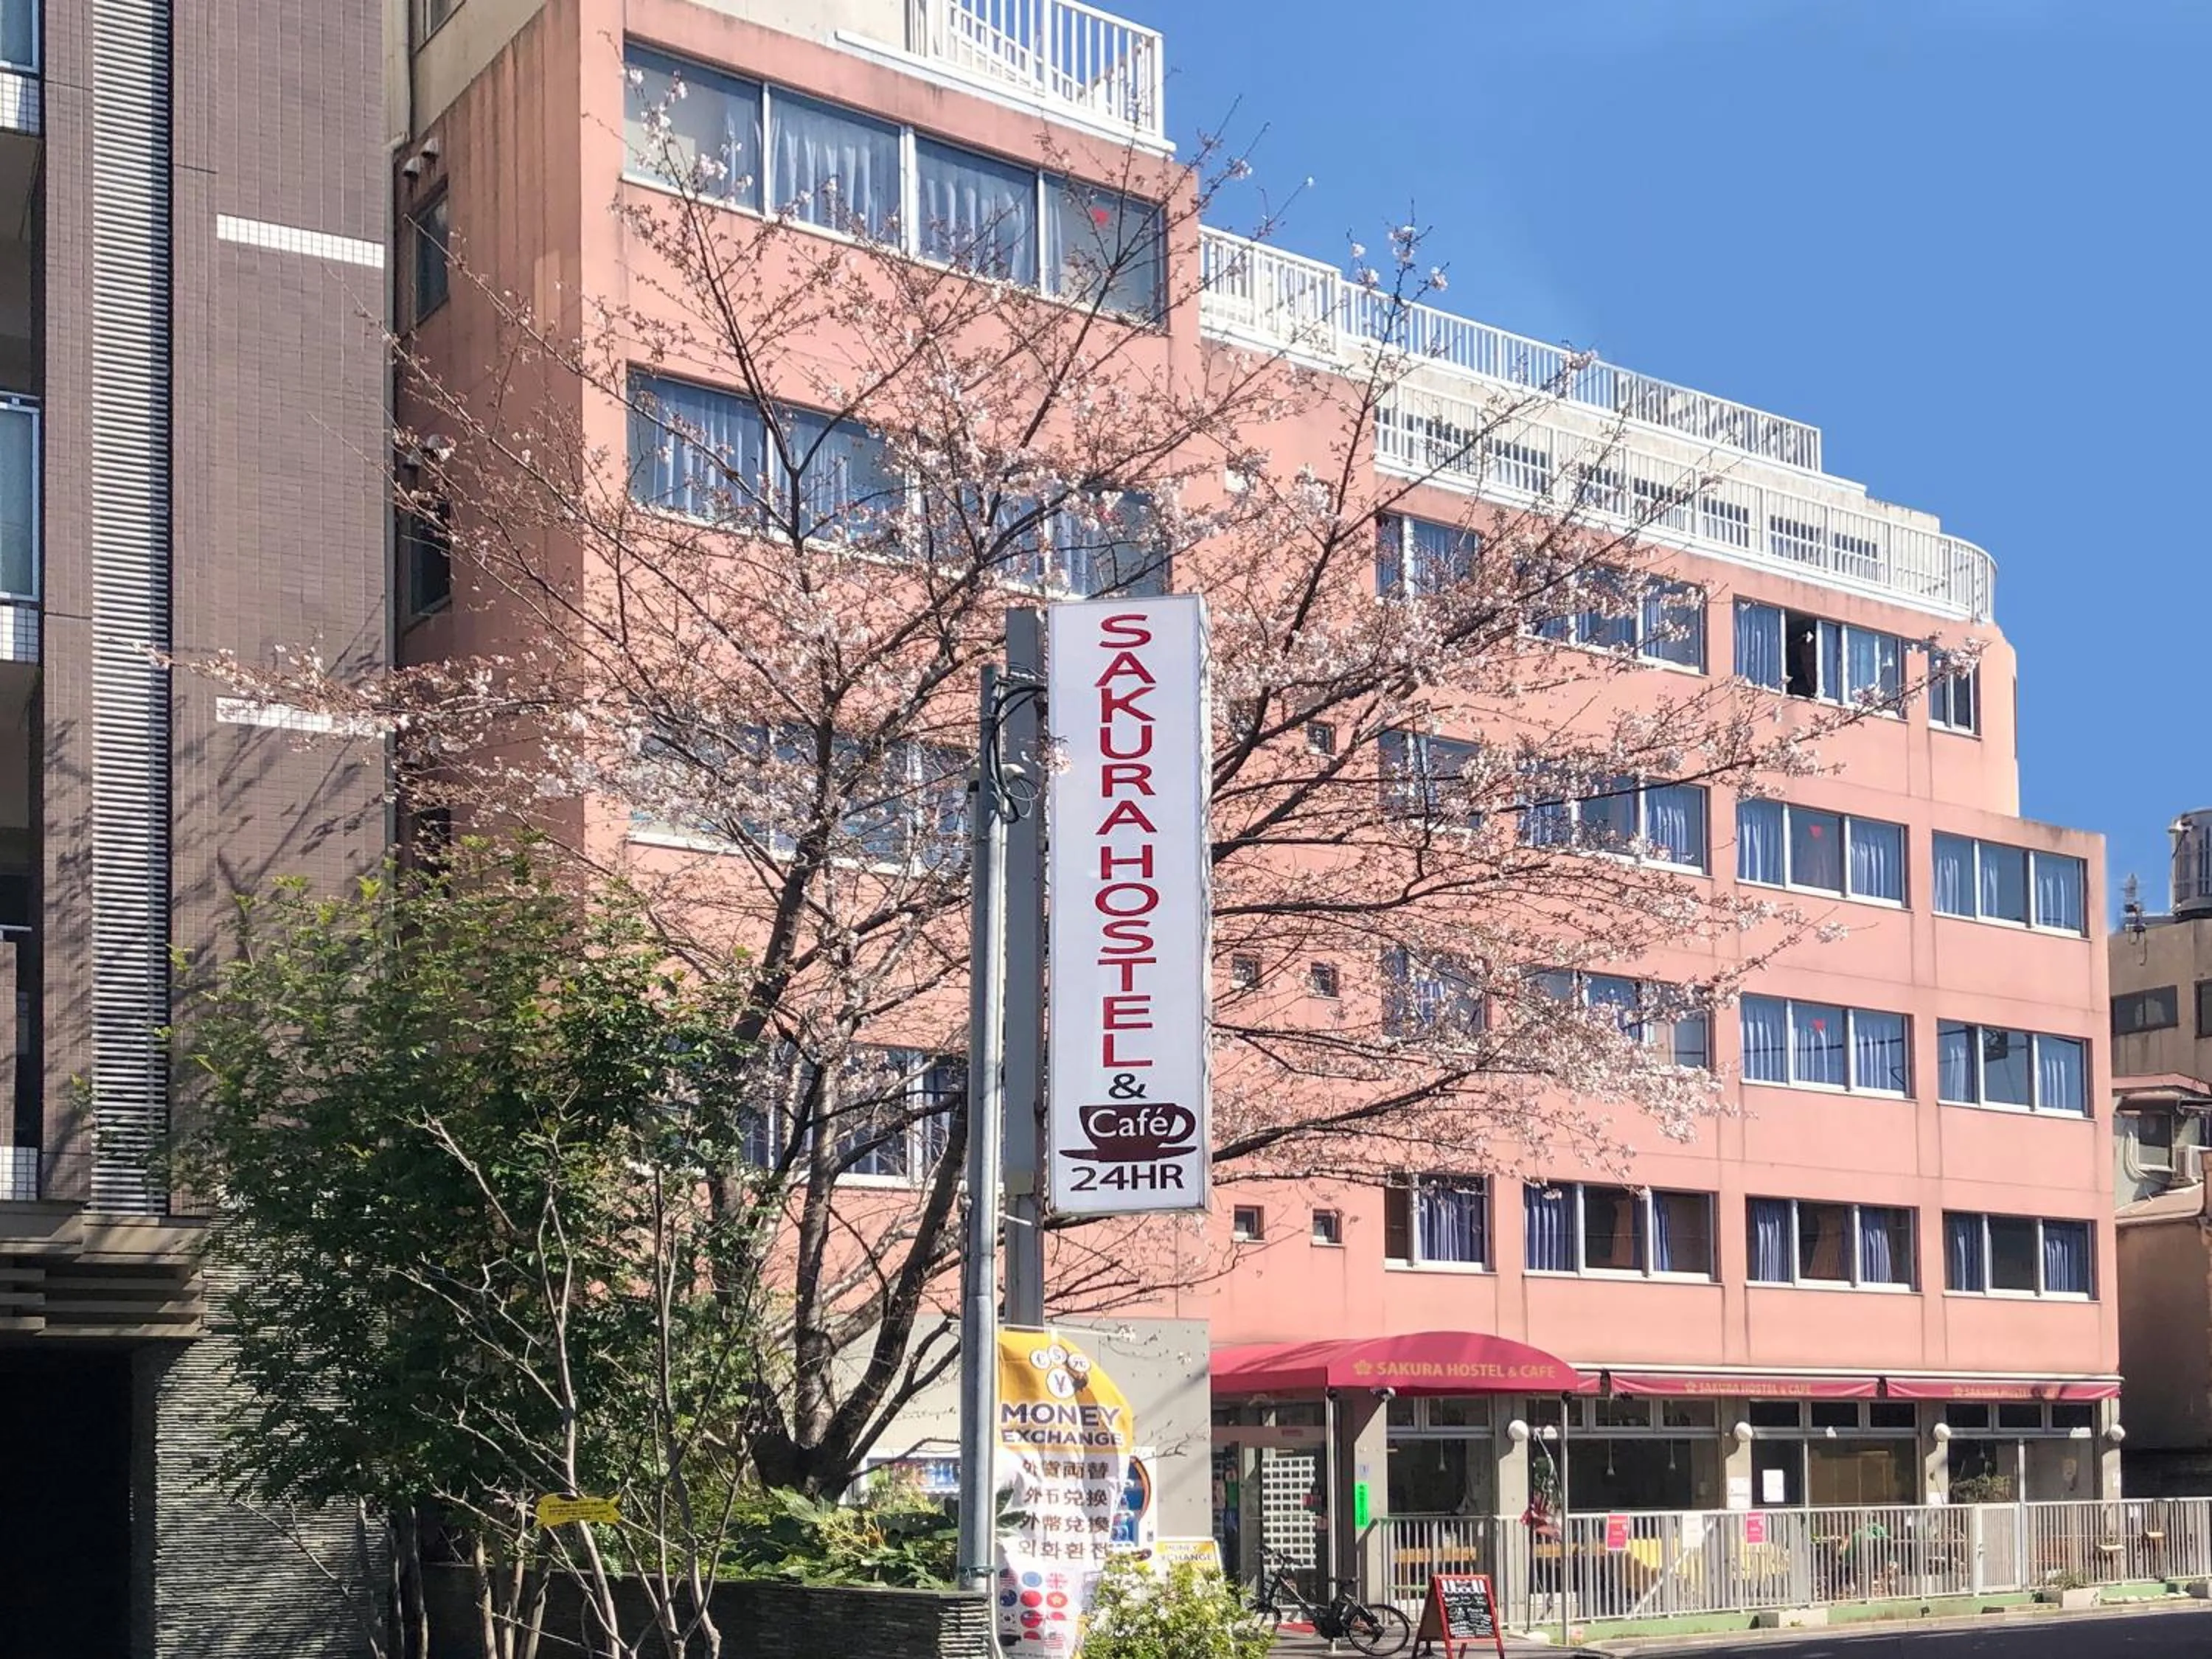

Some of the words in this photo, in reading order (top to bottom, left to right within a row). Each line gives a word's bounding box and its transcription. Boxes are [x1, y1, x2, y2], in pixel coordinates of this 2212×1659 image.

[1094, 613, 1157, 835] SAKURA
[1095, 844, 1159, 1068] HOSTEL
[1108, 1073, 1147, 1099] &
[1088, 1107, 1169, 1137] Café
[1070, 1164, 1184, 1192] 24HR
[1377, 1362, 1444, 1377] SAKURA
[1446, 1363, 1505, 1378] HOSTEL
[1001, 1403, 1120, 1427] MONEY
[1001, 1429, 1123, 1446] EXCHANGE
